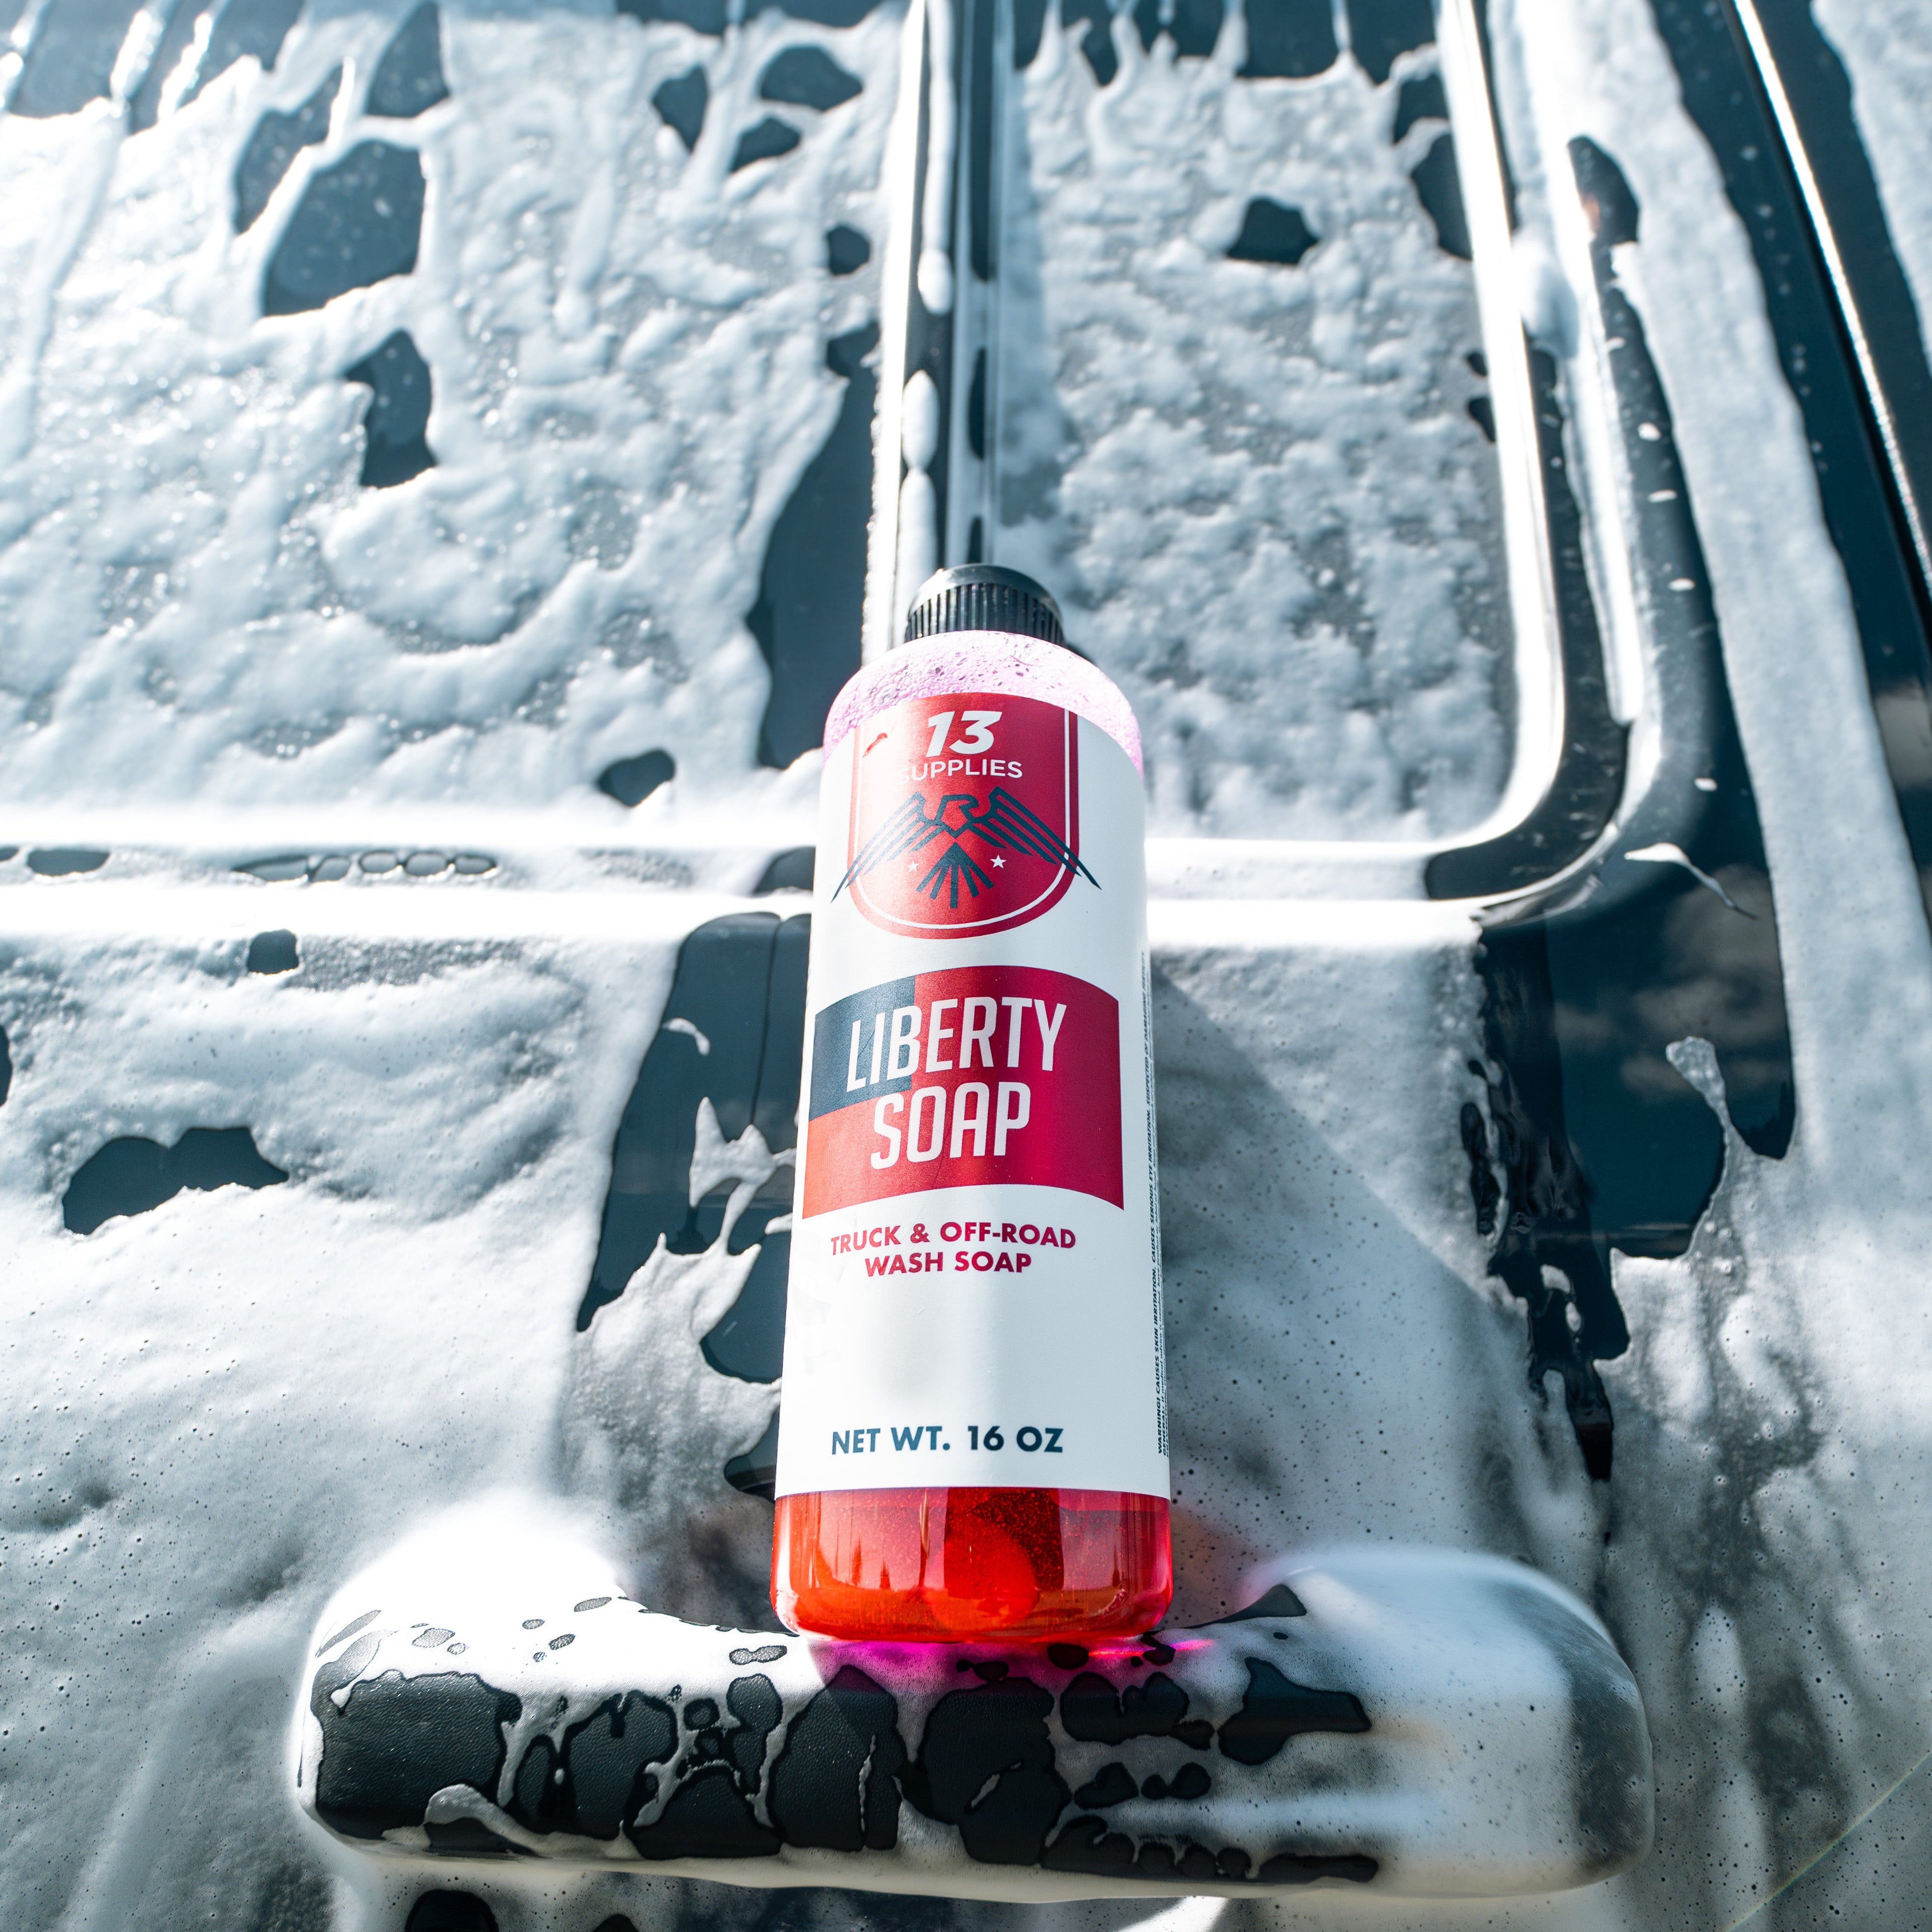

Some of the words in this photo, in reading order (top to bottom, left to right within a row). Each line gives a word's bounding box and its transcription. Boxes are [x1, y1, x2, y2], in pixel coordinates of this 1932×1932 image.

[927, 710, 1002, 758] 13
[898, 759, 1023, 785] SUPPLIES
[846, 996, 1067, 1092] LIBERTY
[870, 1082, 1030, 1170] SOAP
[831, 1225, 902, 1256] TRUCK
[910, 1223, 929, 1243] &
[940, 1221, 1076, 1249] OFF-ROAD
[864, 1253, 943, 1277] WASH
[955, 1251, 1031, 1273] SOAP
[832, 1427, 881, 1455] NET
[891, 1425, 951, 1451] WT.
[967, 1425, 1005, 1452] 16
[1017, 1426, 1064, 1453] OZ
